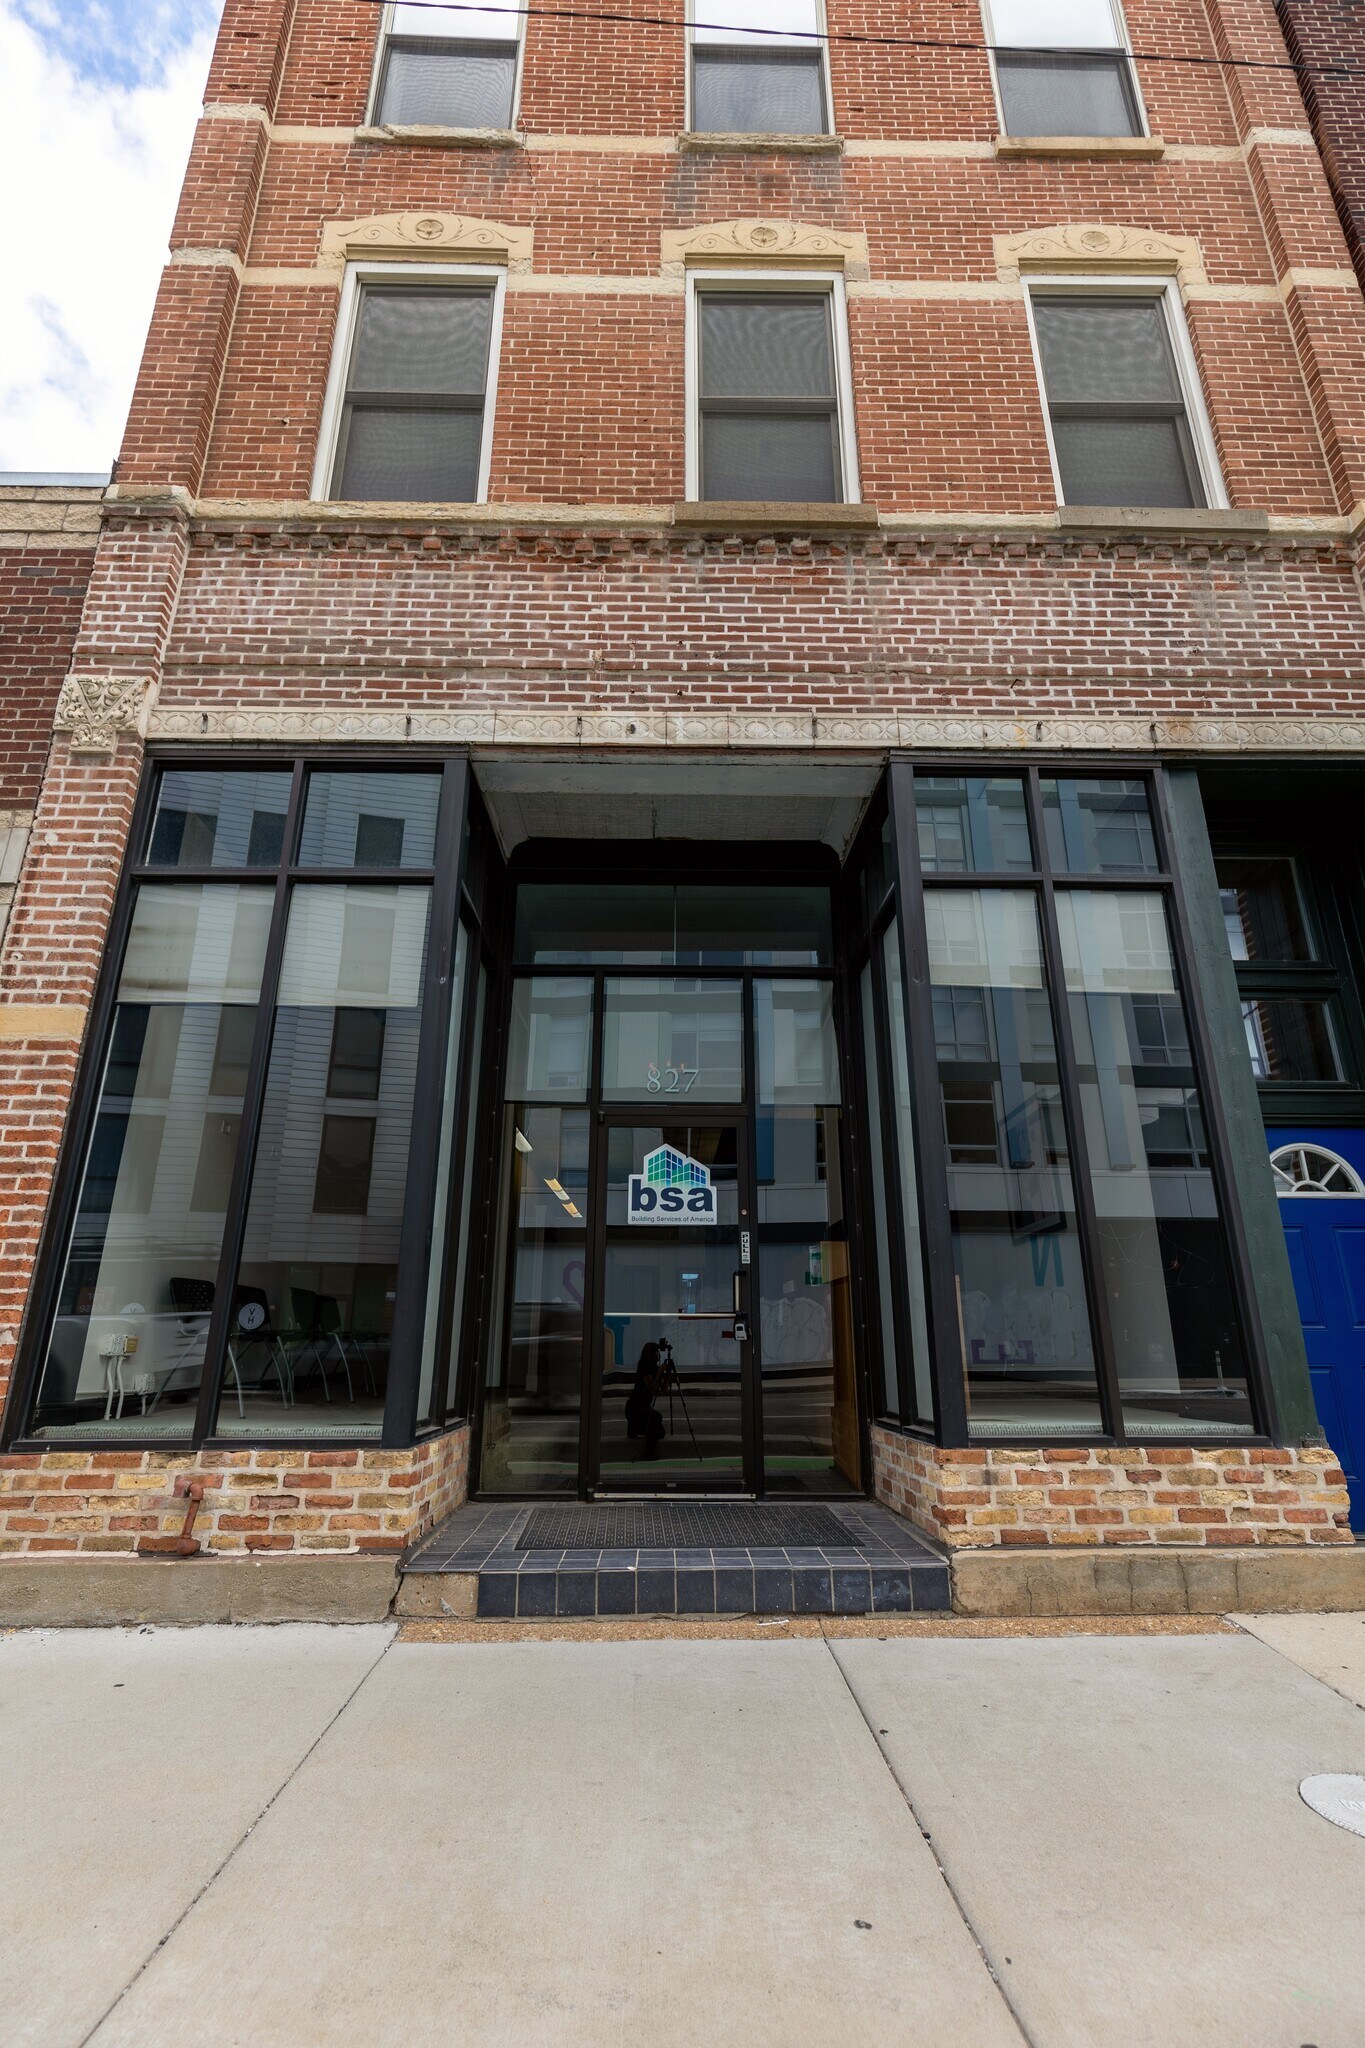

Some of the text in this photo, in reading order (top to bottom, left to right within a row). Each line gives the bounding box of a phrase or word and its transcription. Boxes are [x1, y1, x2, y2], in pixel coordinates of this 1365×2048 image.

[646, 1068, 700, 1093] 827
[631, 1178, 714, 1212] bsa
[631, 1215, 654, 1223] Building
